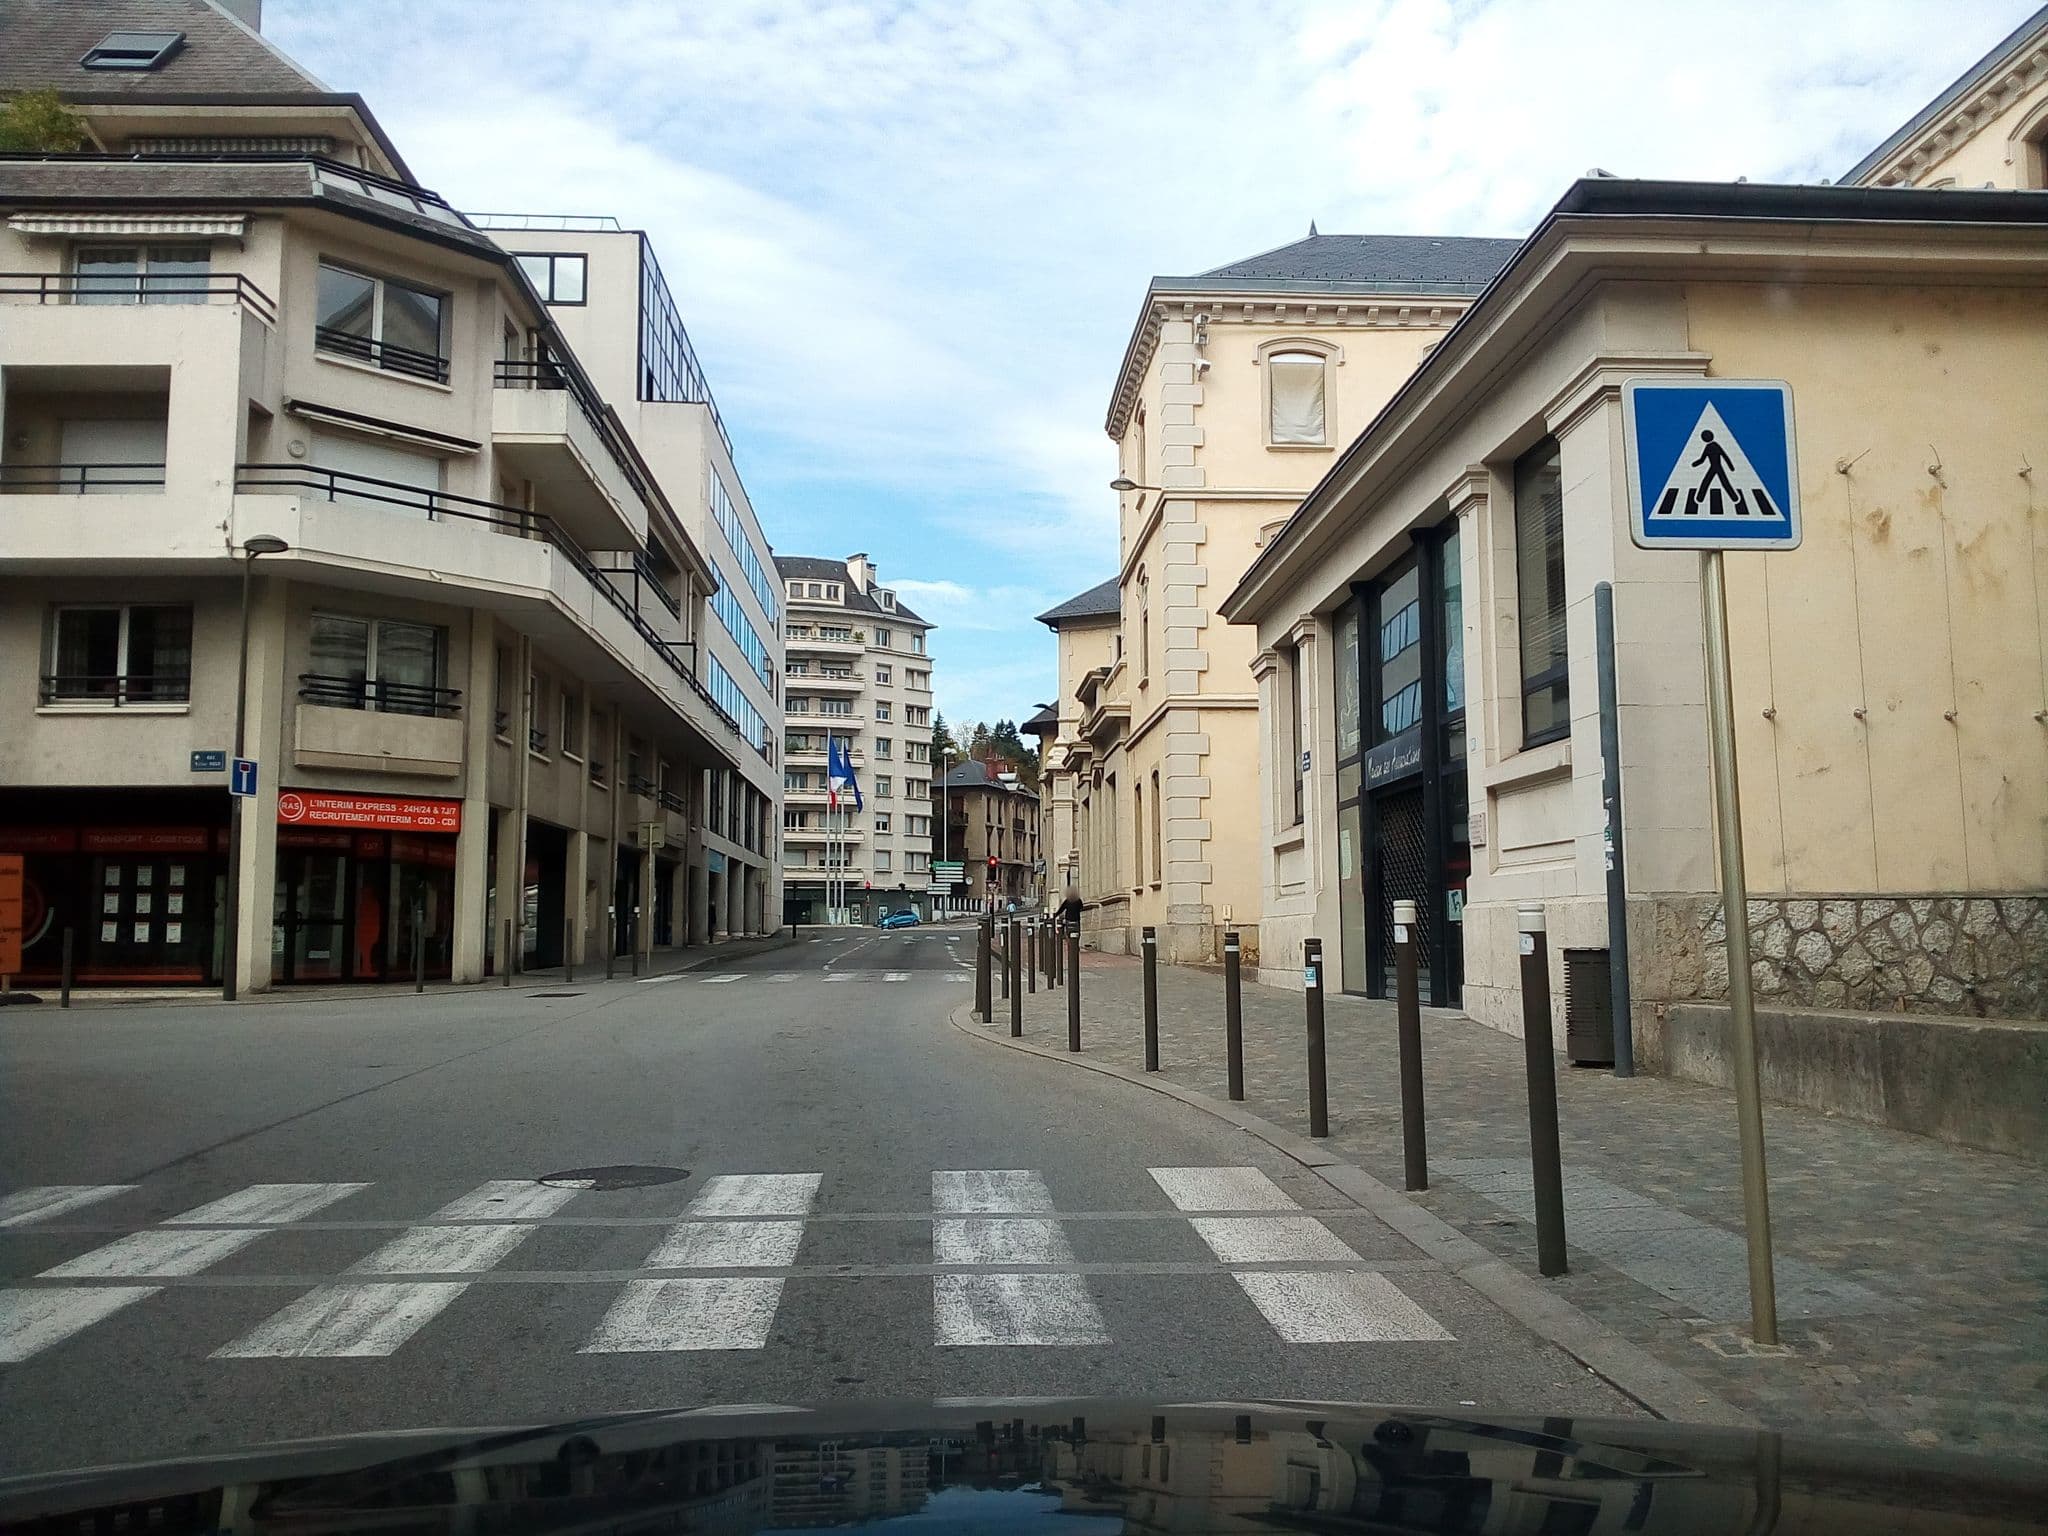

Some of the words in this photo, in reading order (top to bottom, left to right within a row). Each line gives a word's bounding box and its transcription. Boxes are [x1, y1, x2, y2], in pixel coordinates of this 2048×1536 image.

[281, 802, 300, 810] RAS
[309, 800, 354, 809] L'INTERIM
[355, 802, 397, 812] EXPRESS
[403, 805, 431, 814] 24H/24
[309, 811, 375, 822] RECRUTEMENT
[377, 814, 412, 824] INTERIM
[417, 817, 436, 825] CDD
[441, 818, 456, 826] CDI
